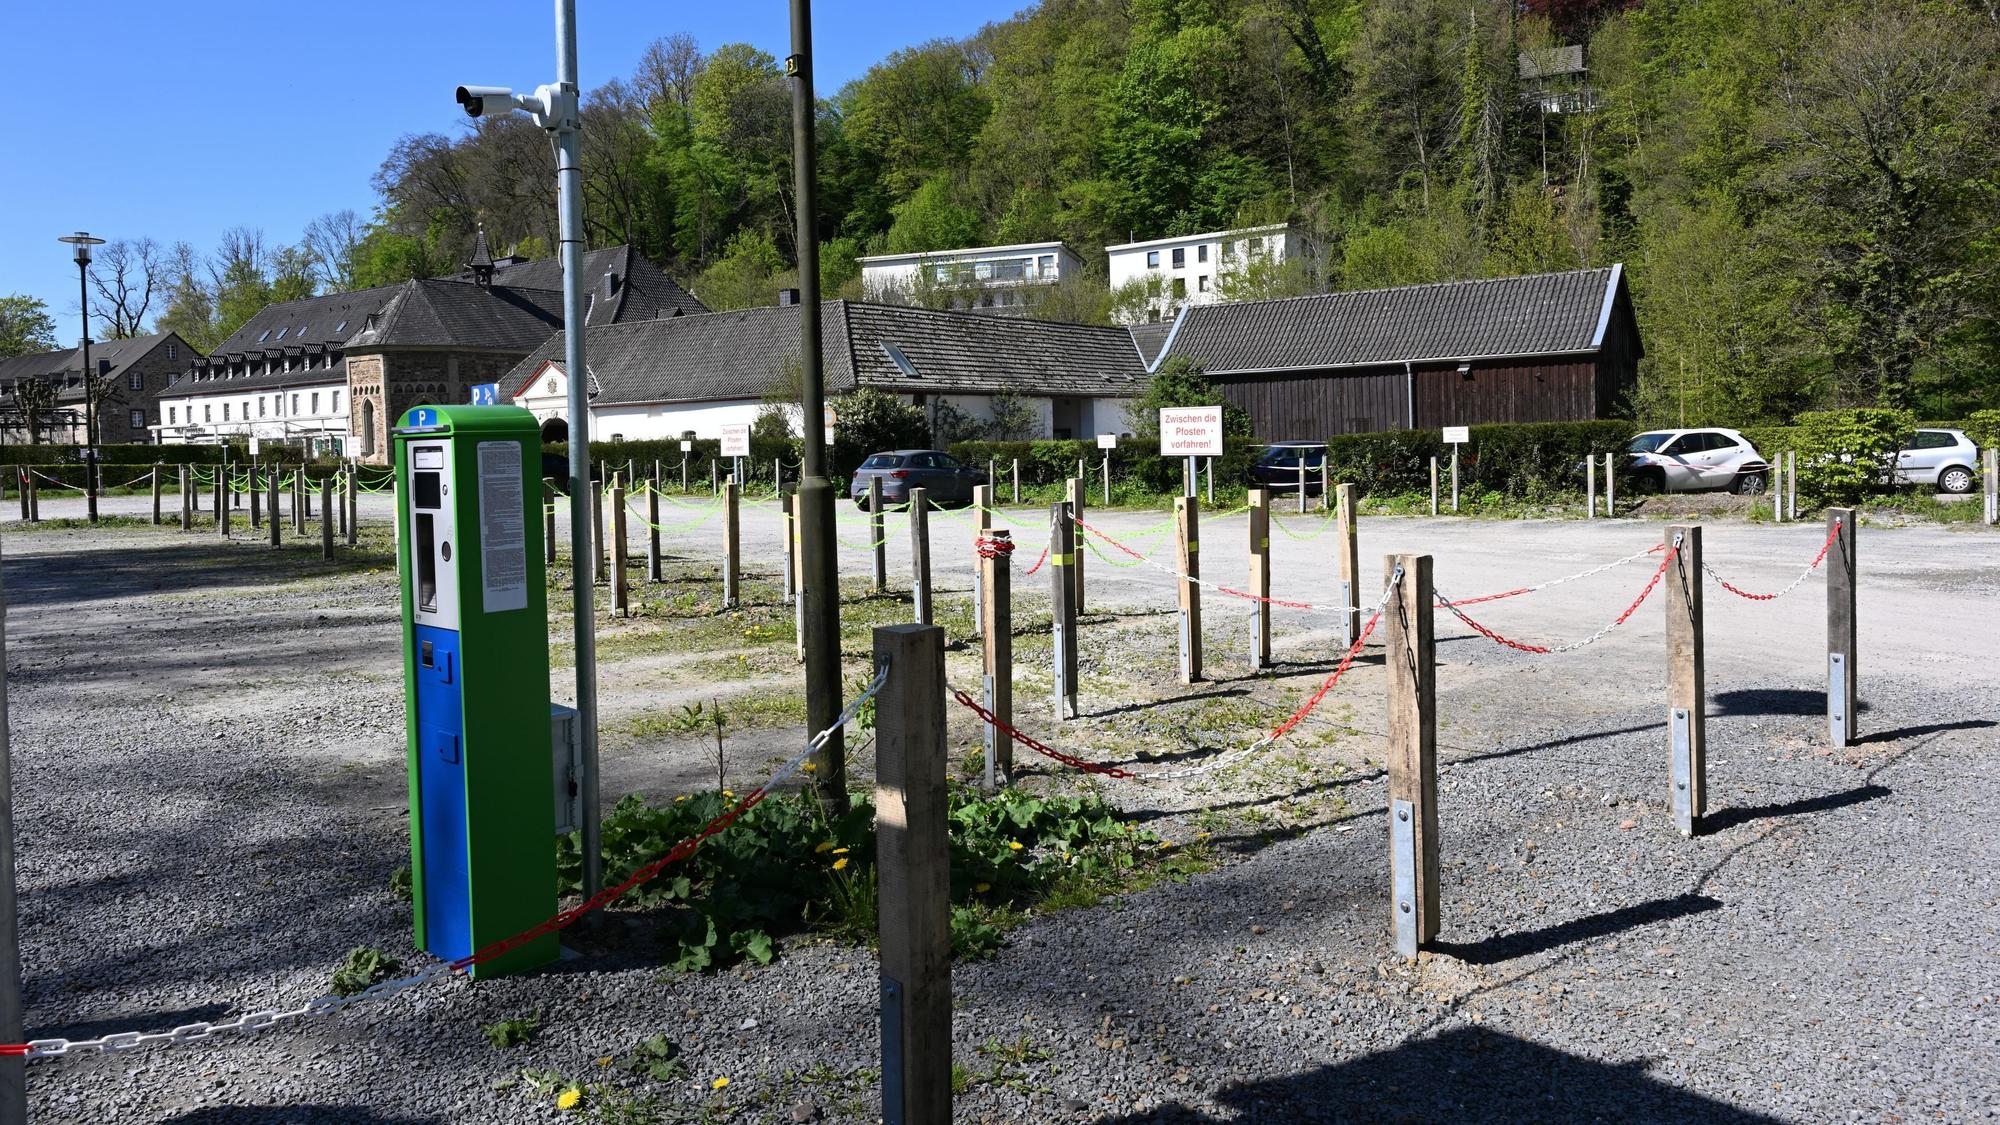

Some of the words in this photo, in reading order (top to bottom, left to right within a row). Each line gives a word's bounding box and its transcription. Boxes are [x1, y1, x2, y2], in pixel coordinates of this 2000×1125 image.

[473, 388, 480, 405] P
[419, 410, 426, 426] P
[1165, 414, 1202, 423] Zwischen
[1204, 414, 1217, 422] die
[1175, 427, 1206, 436] Pfosten
[1171, 440, 1211, 449] vorfahren!
